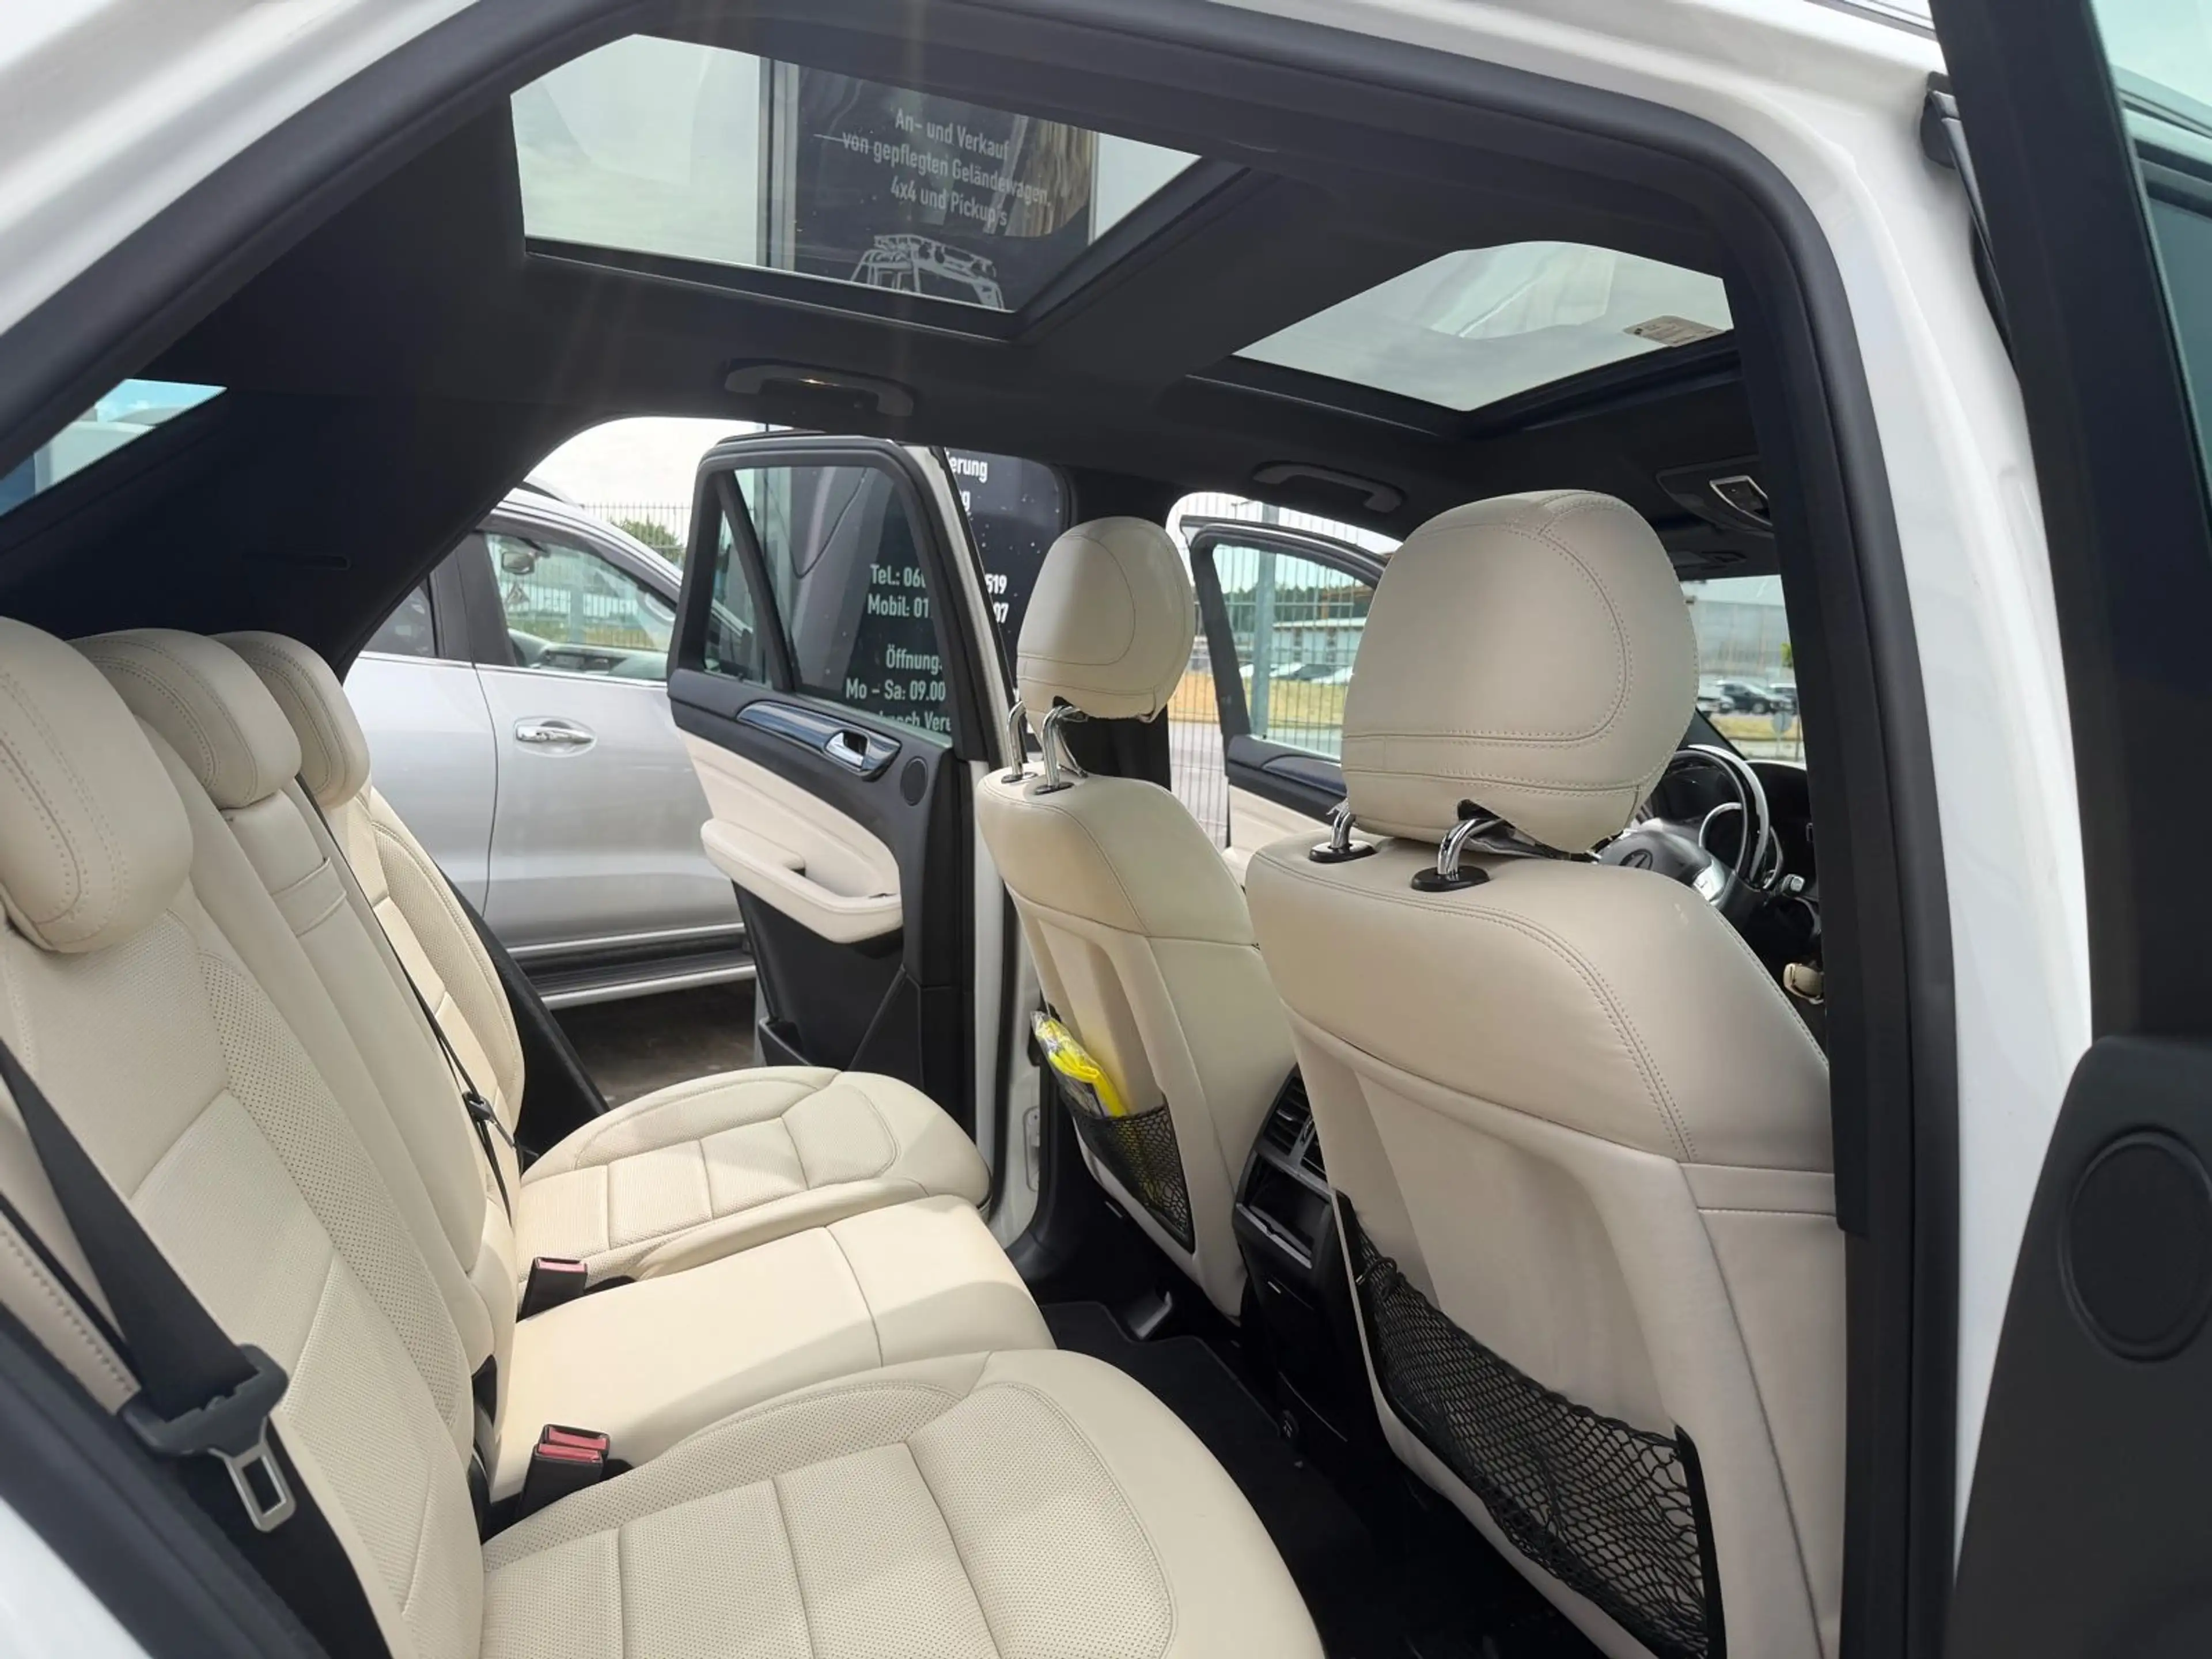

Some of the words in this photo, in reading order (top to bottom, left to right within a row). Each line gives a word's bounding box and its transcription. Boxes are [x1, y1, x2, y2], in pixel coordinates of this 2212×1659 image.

[842, 132, 869, 155] von
[873, 141, 949, 176] gepflegten
[927, 122, 953, 144] und
[957, 124, 1009, 161] Verkauf
[891, 175, 917, 202] 4x4
[920, 188, 946, 210] und
[945, 451, 988, 483] erung
[869, 563, 900, 586] Tel.:
[868, 593, 910, 616] Mobil:
[885, 643, 942, 676] Öffnung
[846, 679, 868, 700] Mo
[884, 680, 907, 700] Sa:
[910, 680, 946, 702] 09.00
